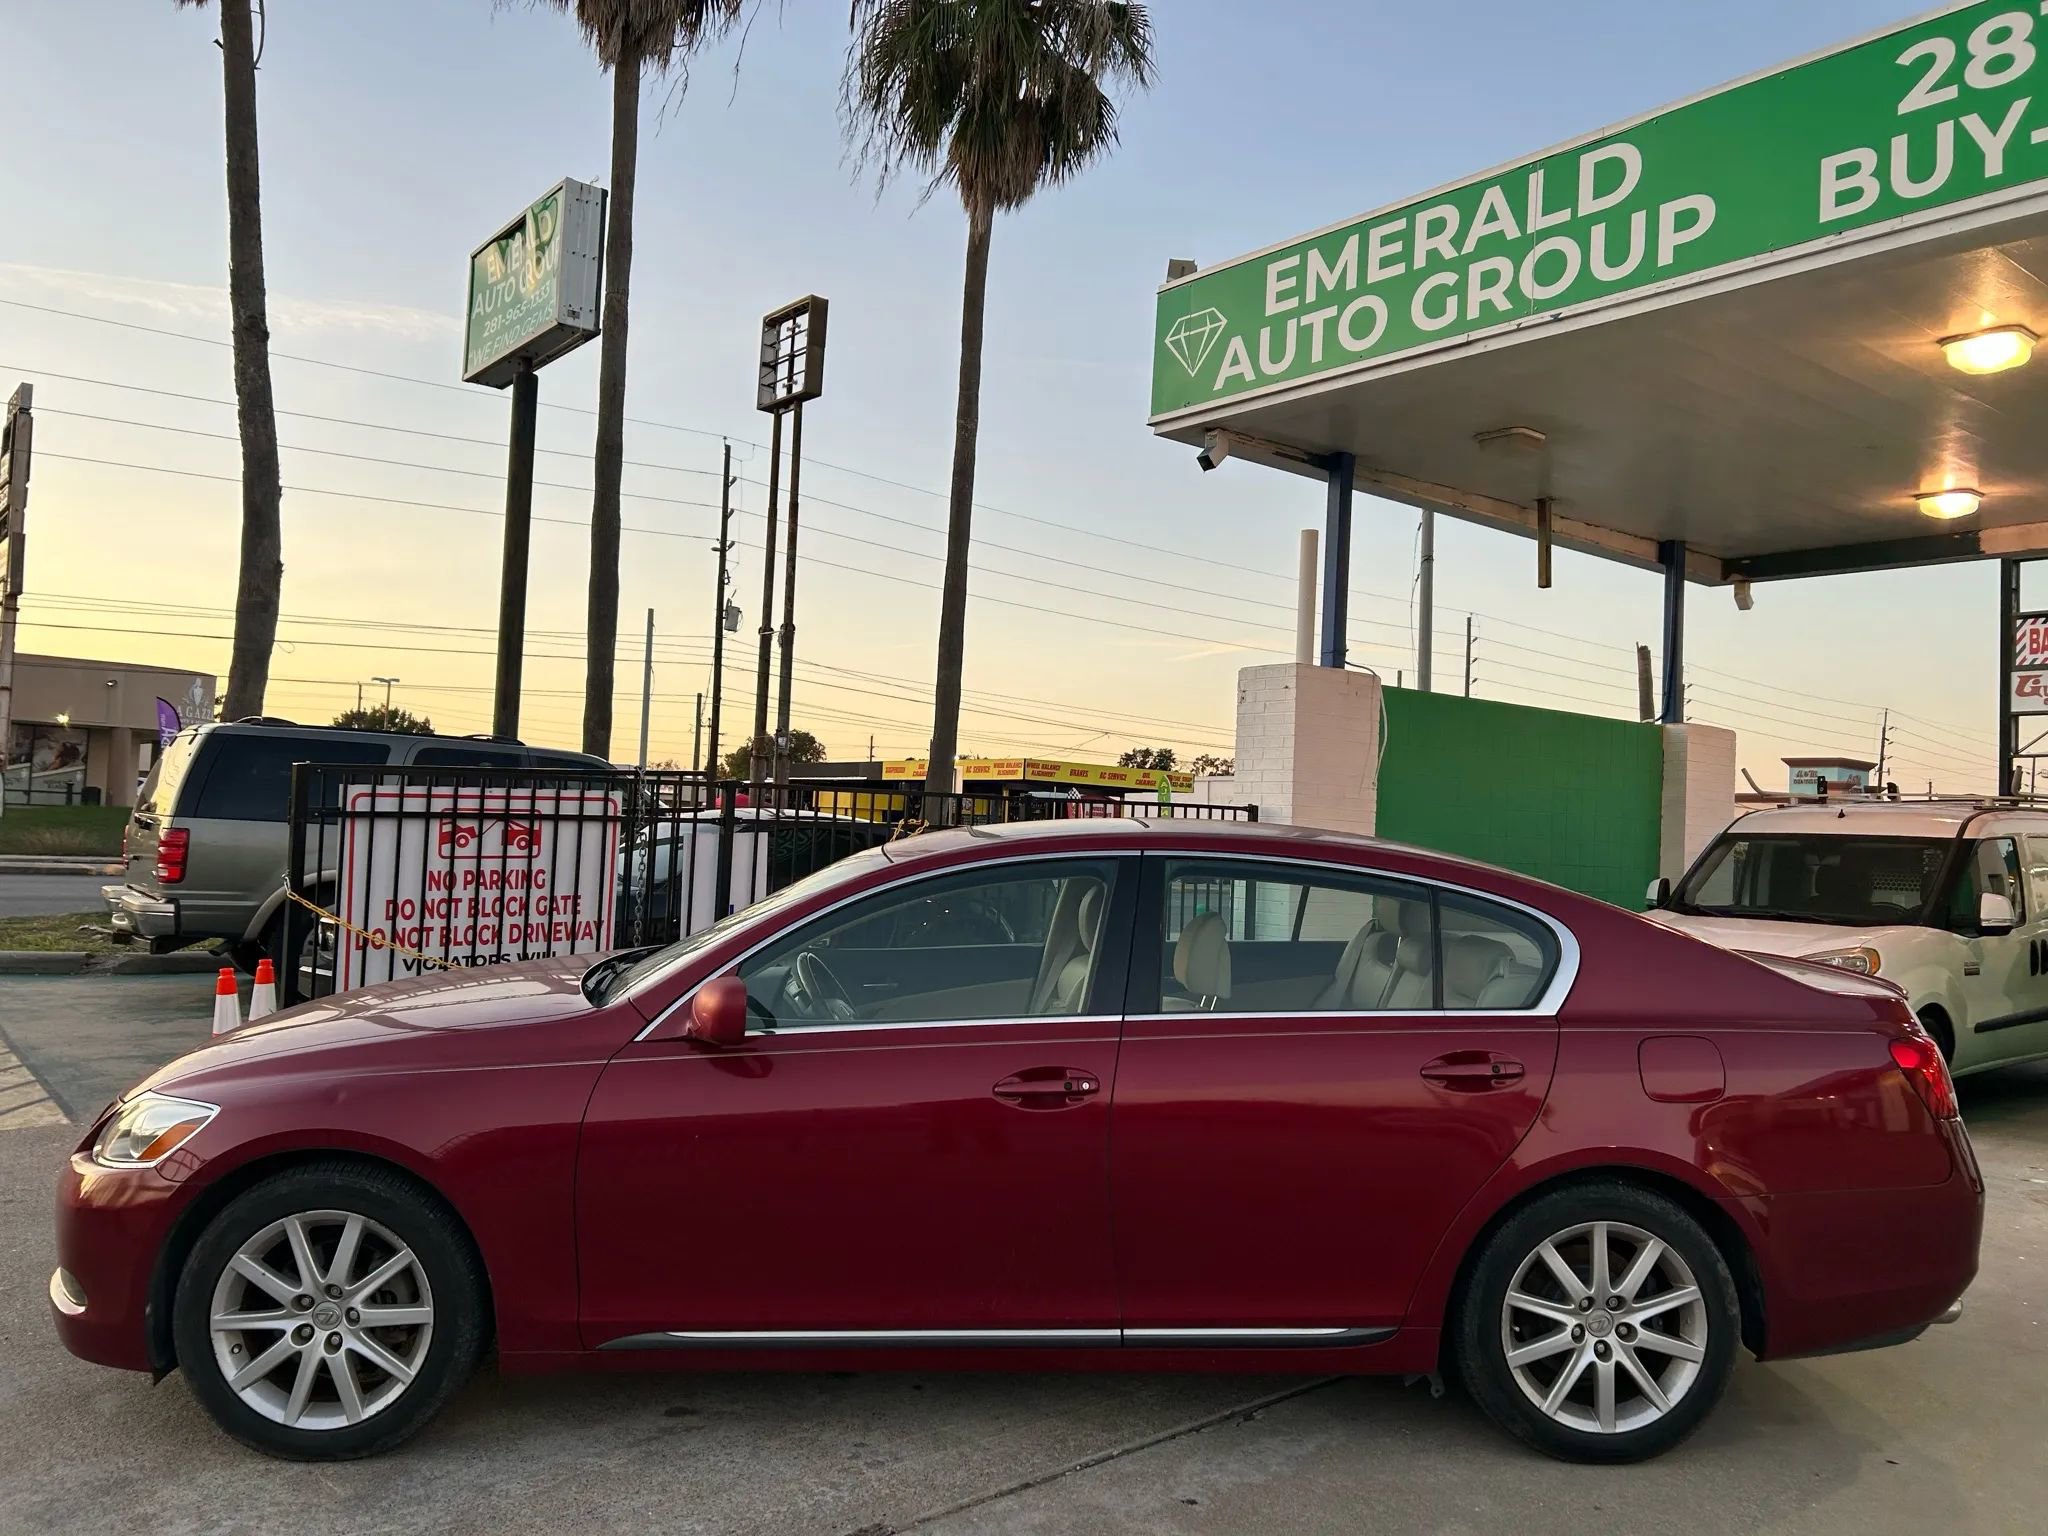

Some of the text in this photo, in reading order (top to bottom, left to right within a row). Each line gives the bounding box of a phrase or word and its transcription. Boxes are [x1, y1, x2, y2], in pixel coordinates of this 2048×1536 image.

[1895, 0, 2048, 116] 28
[1265, 142, 1643, 317] EMERALD
[471, 276, 516, 319] AUTO
[1213, 193, 1716, 391] AUTO GROUP
[428, 869, 546, 891] NO PARKING
[385, 895, 581, 921] DO NOT BLOCK GATE
[355, 920, 604, 951] DO NOT BLOCK DRIVEWAY
[402, 952, 511, 972] VOLATORS
